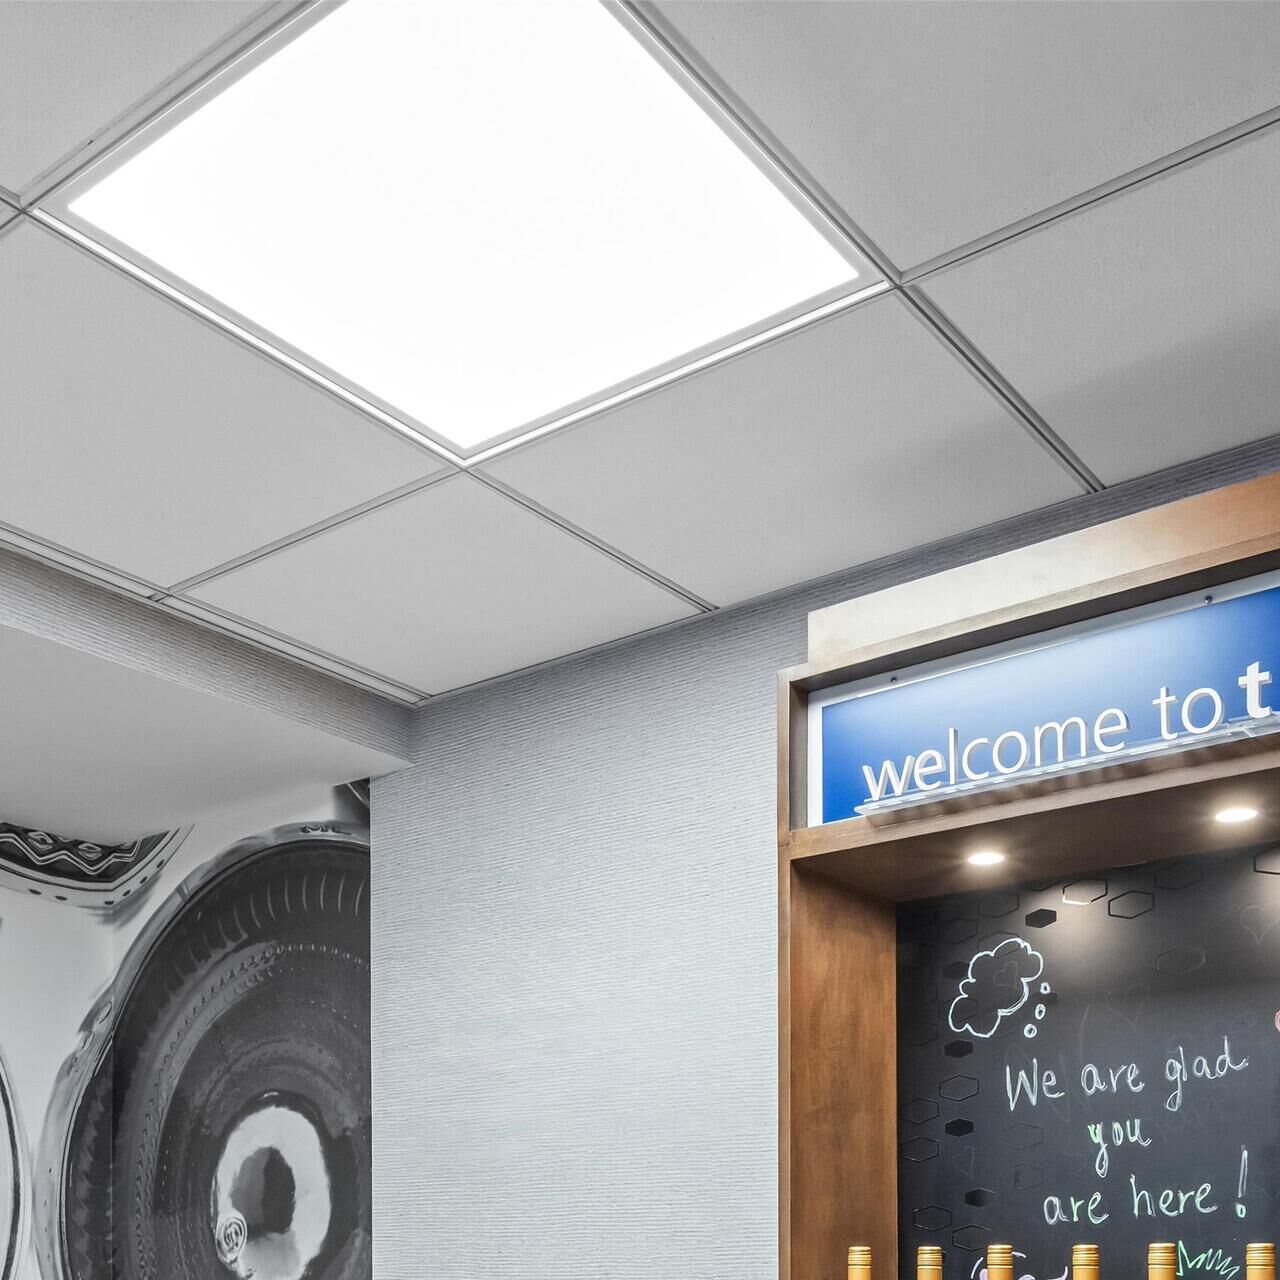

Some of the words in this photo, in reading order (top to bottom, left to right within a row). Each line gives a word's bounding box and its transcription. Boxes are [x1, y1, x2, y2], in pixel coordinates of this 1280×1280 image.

[862, 704, 1128, 803] welcome
[1152, 684, 1224, 742] to
[1005, 1059, 1064, 1111] We
[1080, 1063, 1144, 1095] are
[1165, 1036, 1249, 1111] glad
[1087, 1116, 1152, 1178] you
[1043, 1191, 1110, 1225] are
[1130, 1175, 1218, 1217] here
